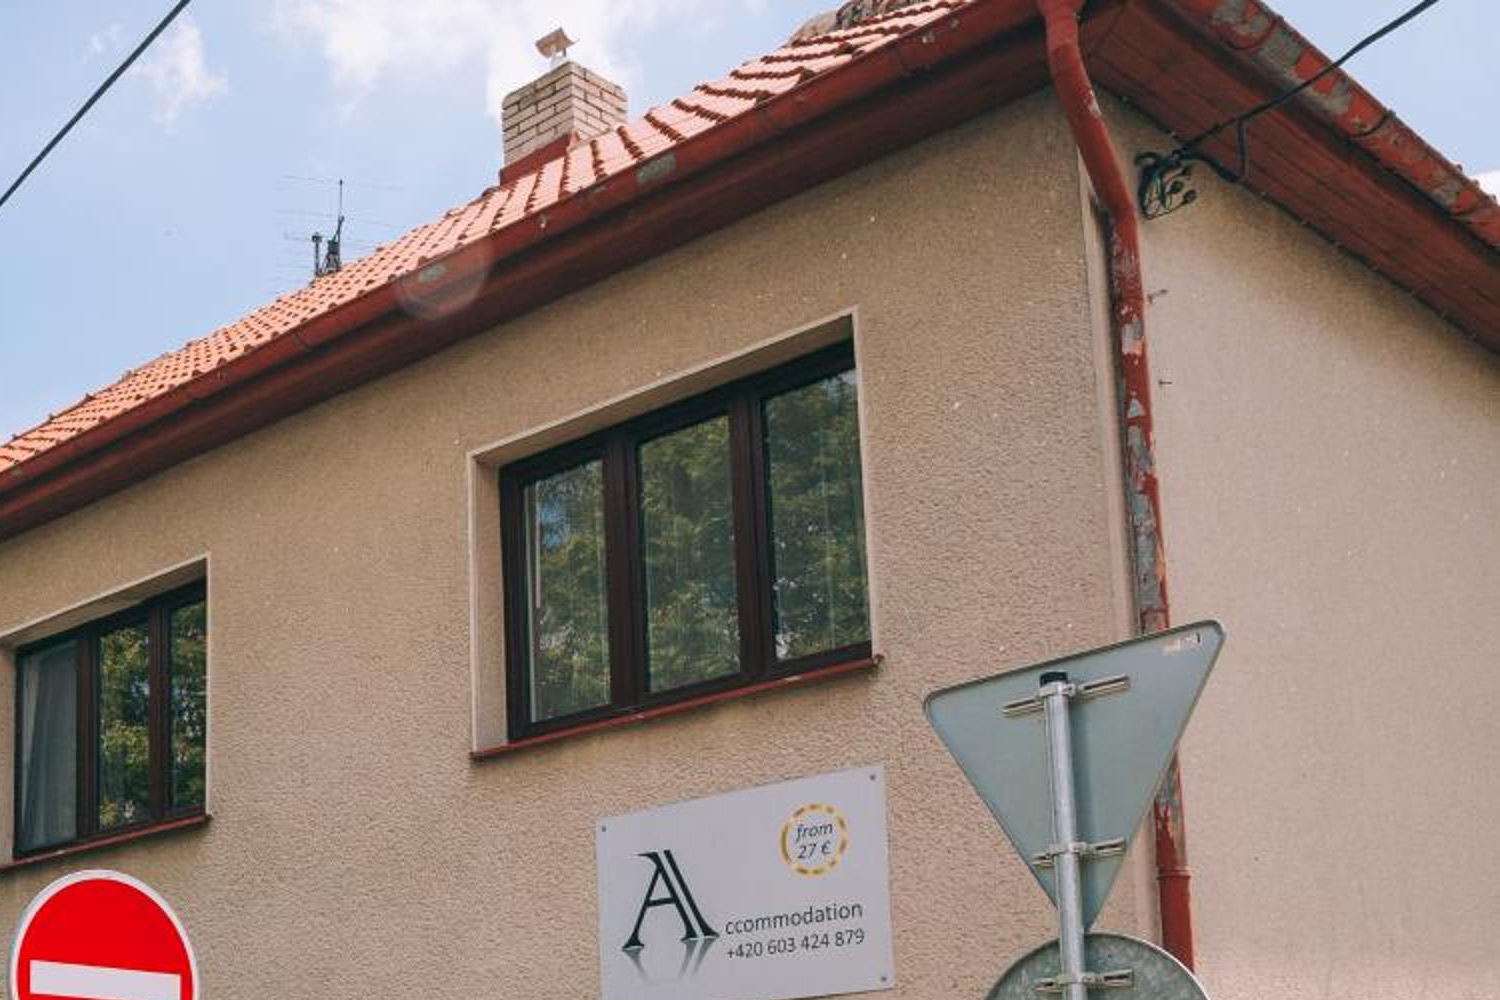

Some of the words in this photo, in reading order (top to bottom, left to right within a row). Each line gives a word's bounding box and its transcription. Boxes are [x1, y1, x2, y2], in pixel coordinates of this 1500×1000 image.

[796, 823, 833, 843] from
[798, 843, 817, 859] 27
[821, 839, 832, 855] €
[727, 942, 763, 959] +420
[767, 937, 796, 955] 603
[801, 934, 829, 951] 424
[835, 928, 865, 947] 879
